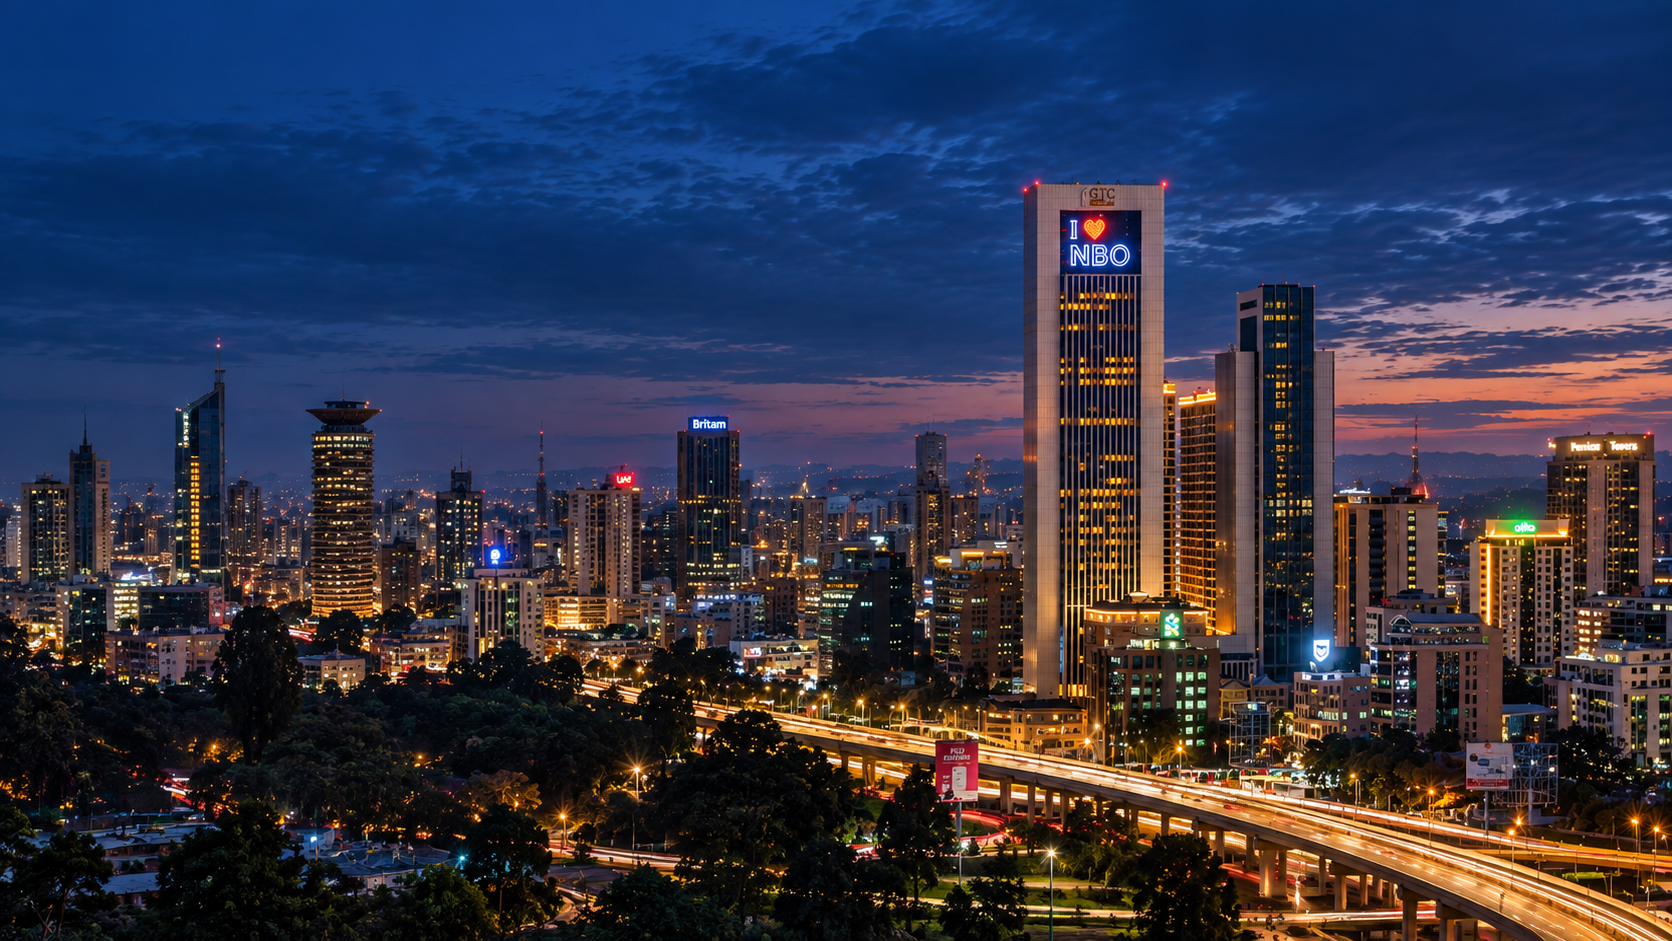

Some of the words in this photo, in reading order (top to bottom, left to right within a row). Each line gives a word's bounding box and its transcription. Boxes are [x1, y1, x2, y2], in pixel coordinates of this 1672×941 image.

[1089, 187, 1115, 201] GTC
[1070, 219, 1078, 240] I
[1070, 244, 1131, 267] NBO
[692, 418, 726, 429] Britam
